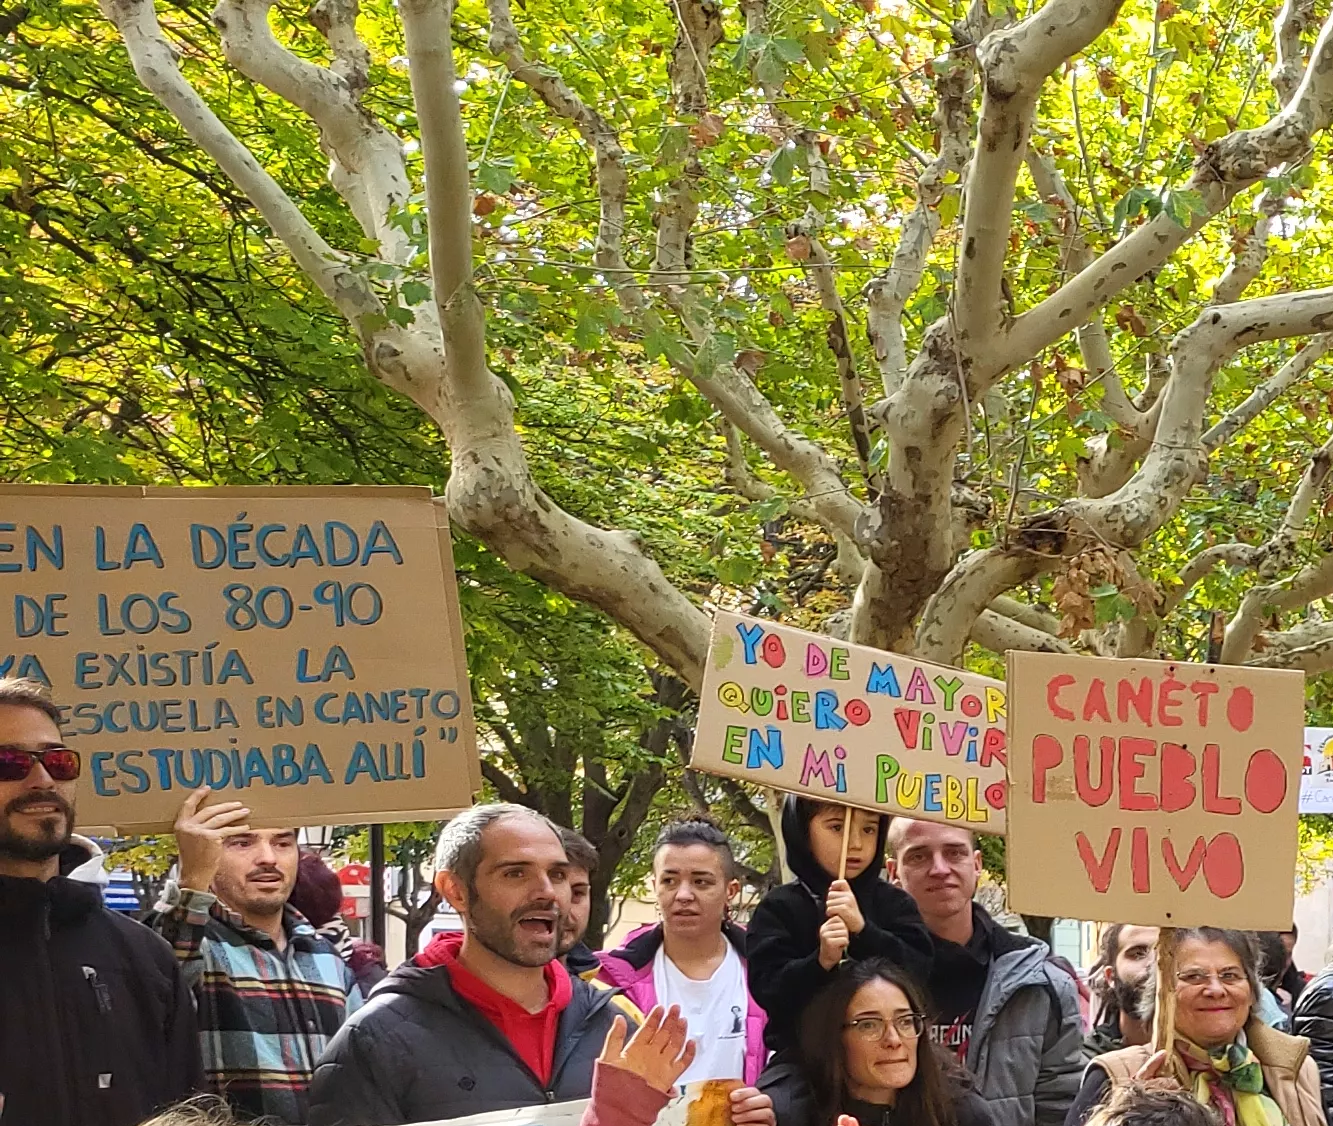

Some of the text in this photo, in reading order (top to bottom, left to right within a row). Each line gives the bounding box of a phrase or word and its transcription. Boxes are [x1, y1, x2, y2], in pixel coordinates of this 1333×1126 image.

[95, 521, 165, 570] LA
[190, 511, 403, 570] DÉCADA
[15, 580, 384, 638] DE LOS 80-90
[296, 644, 356, 683] LA
[736, 621, 1006, 724] YO DE MAYOR
[55, 687, 461, 737] ESCUELA EN CANETO
[721, 725, 784, 770] EN
[874, 753, 1007, 823] PUEBLO
[1032, 732, 1288, 815] PUEBLO
[1075, 826, 1245, 899] VIVO
